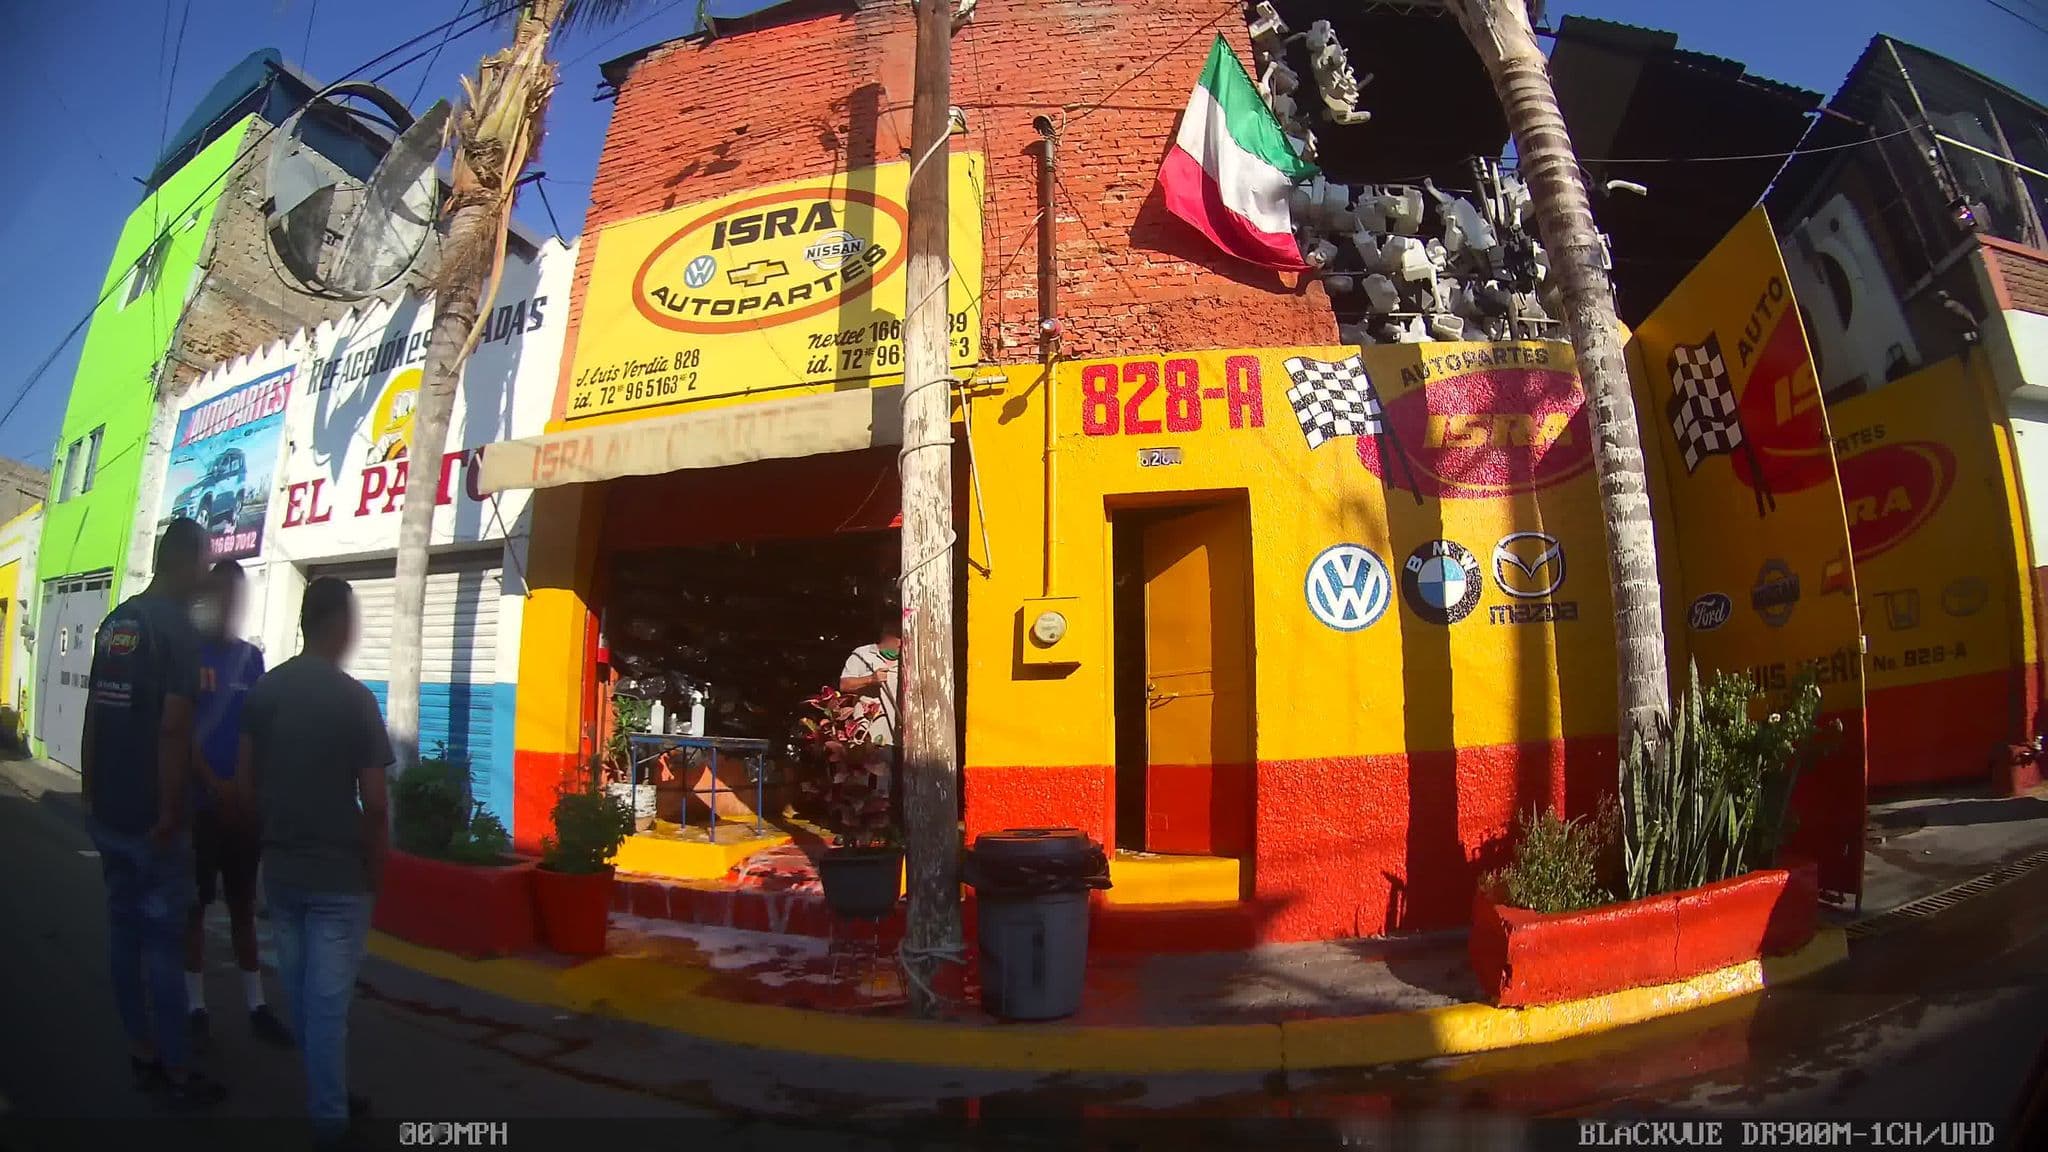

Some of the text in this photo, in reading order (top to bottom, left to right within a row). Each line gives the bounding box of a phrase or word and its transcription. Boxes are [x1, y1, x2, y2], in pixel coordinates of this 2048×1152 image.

[711, 201, 837, 250] ISRA
[806, 241, 861, 261] NISSAN
[650, 244, 887, 316] AUTOPARTES
[1738, 275, 1783, 368] AUTO
[673, 348, 700, 370] 828
[1401, 347, 1550, 388] AUTOPARTES
[188, 371, 293, 445] AUTOPARTES
[1081, 355, 1266, 436] 828-A
[1423, 411, 1573, 448] ISRA
[532, 435, 594, 481] ISRA
[282, 479, 334, 528] EL
[1489, 602, 1578, 624] mazda
[1692, 599, 1725, 627] Ford
